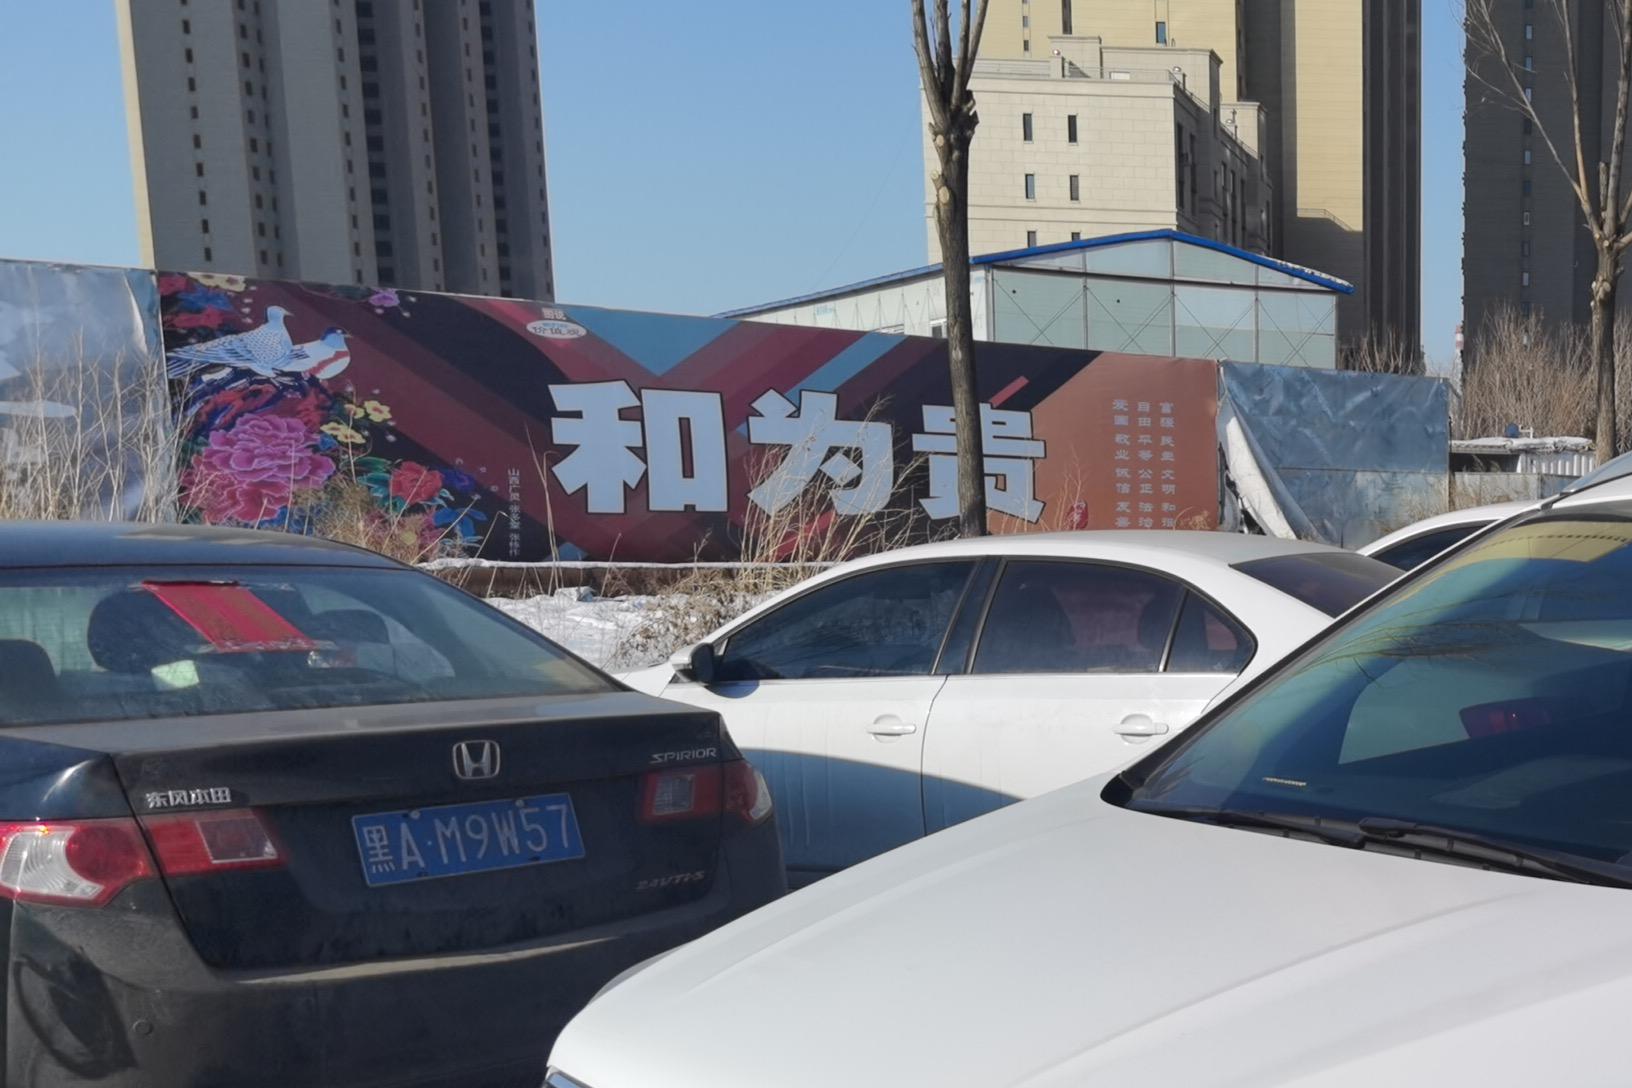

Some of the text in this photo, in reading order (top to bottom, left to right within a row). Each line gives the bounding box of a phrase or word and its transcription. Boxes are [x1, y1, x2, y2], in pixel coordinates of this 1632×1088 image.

[547, 379, 1046, 524] 和为贵
[649, 747, 717, 764] SPIRIOR
[145, 787, 232, 808] 东风本田
